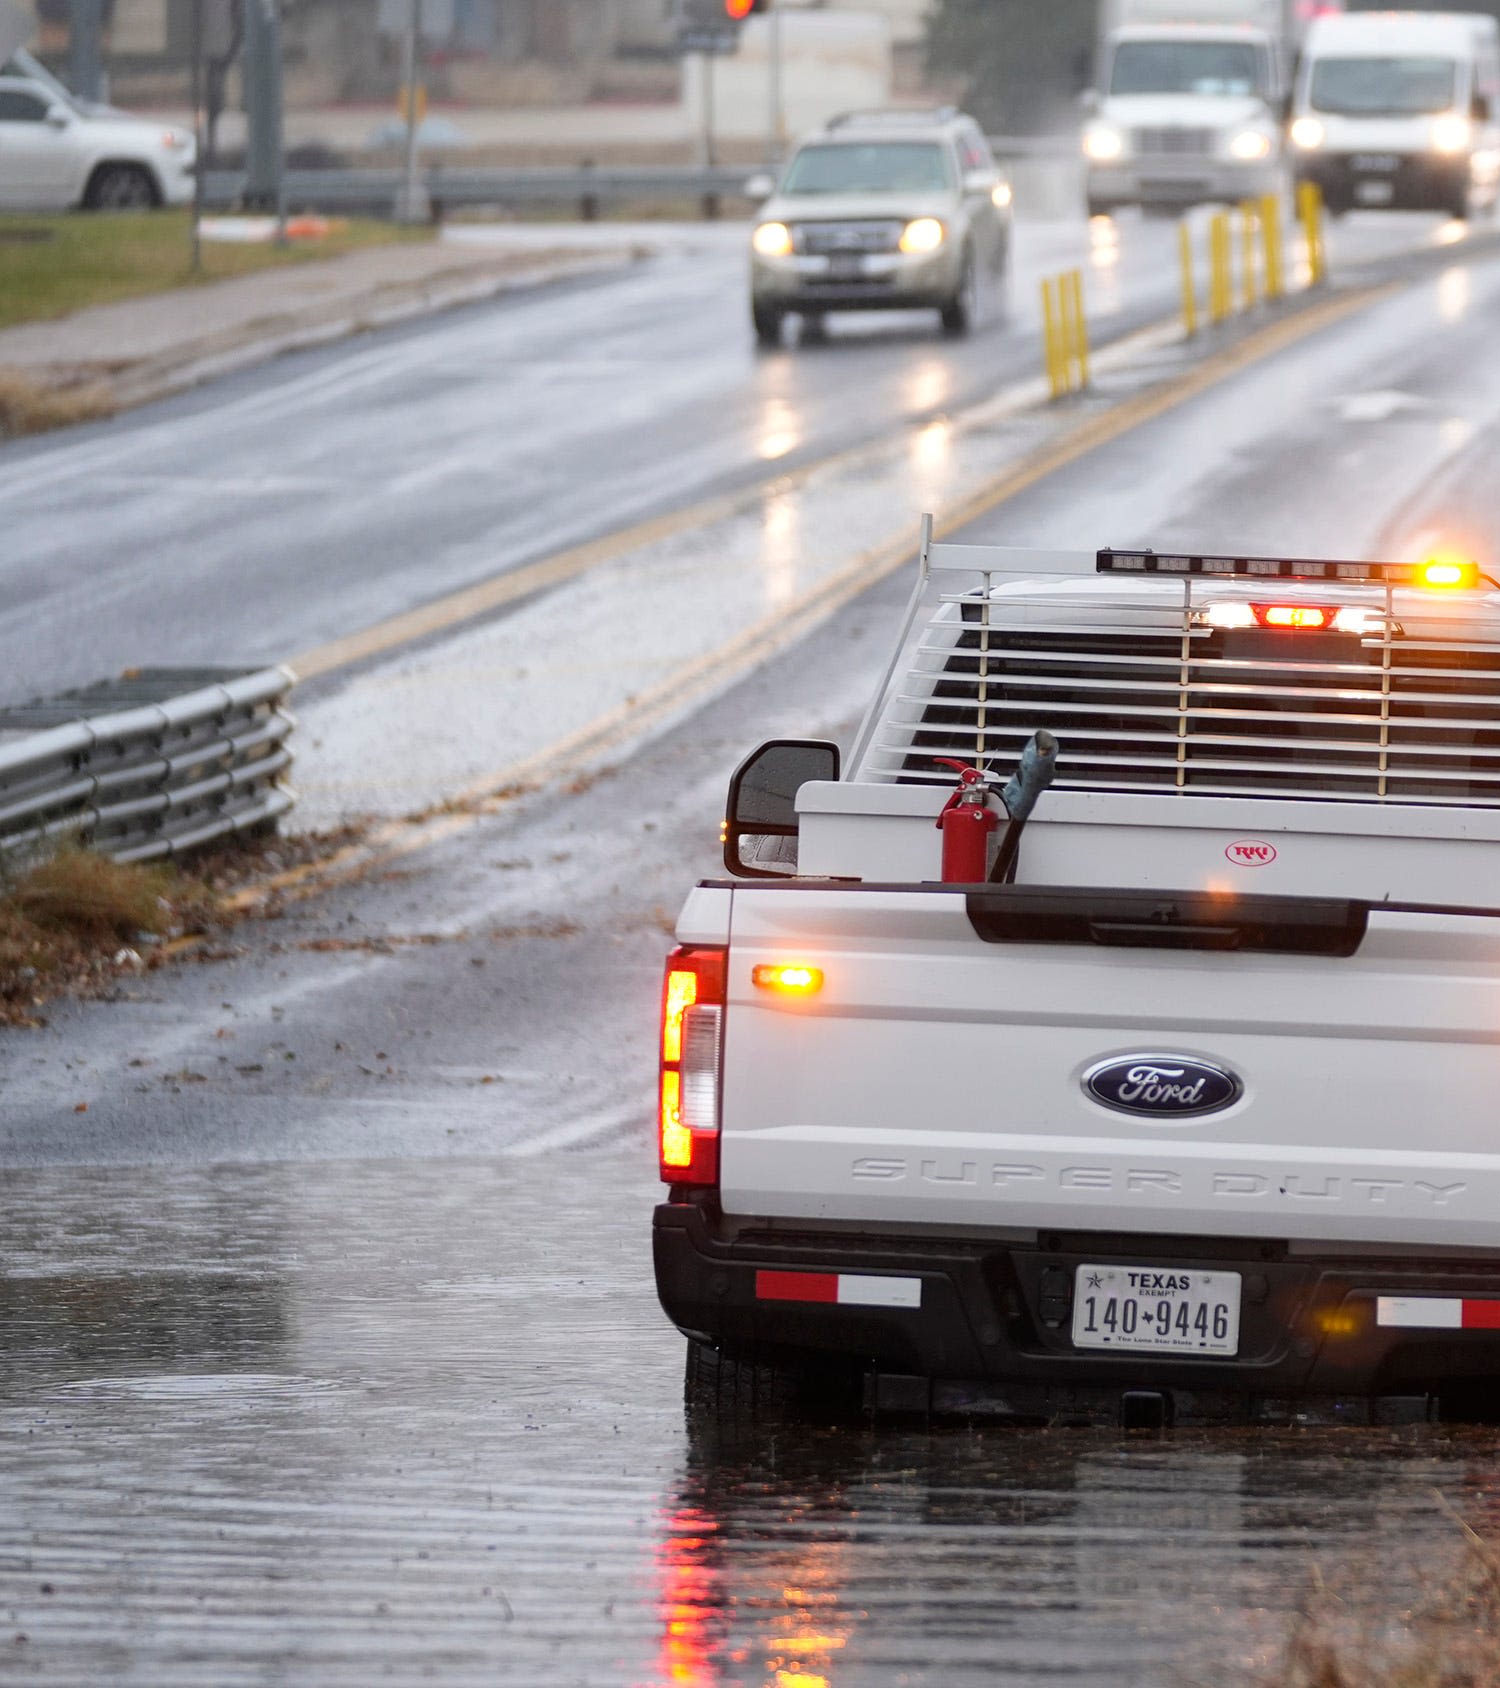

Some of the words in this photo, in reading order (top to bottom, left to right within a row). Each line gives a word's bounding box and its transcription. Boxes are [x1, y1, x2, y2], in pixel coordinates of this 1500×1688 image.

[1118, 1066, 1206, 1103] Ford
[851, 1157, 1182, 1193] SUPER
[1213, 1172, 1467, 1204] DUTY
[1128, 1273, 1190, 1290] TEXAS
[1139, 1289, 1176, 1297] EXEMPT
[1117, 1335, 1132, 1343] The
